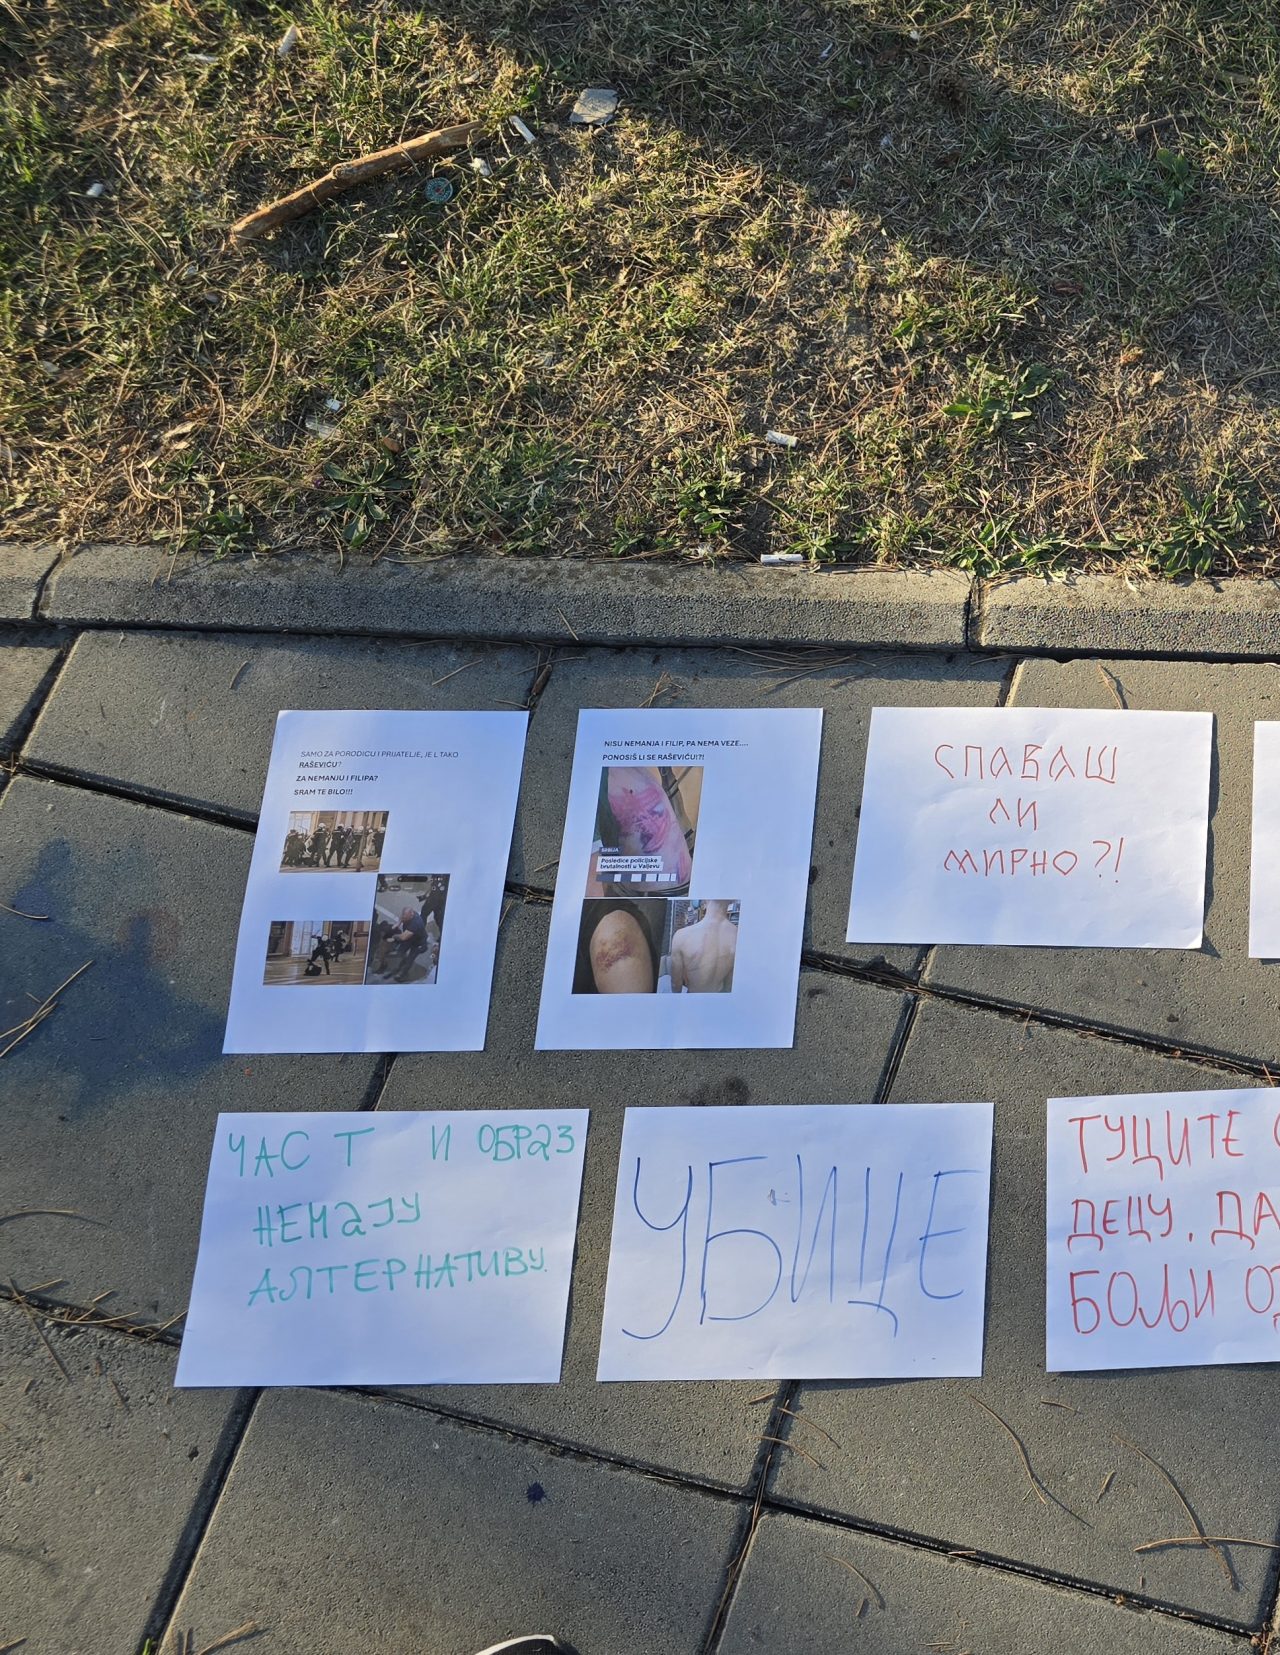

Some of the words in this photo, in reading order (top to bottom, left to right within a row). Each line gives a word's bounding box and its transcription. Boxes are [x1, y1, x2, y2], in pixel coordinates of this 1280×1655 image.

[300, 750, 323, 758] SAMO
[665, 740, 685, 748] FILIP,
[327, 788, 354, 796] BILO!!!
[988, 797, 1038, 831] ЛИ
[431, 1124, 450, 1161] И
[622, 1154, 982, 1340] УБИЦЕ
